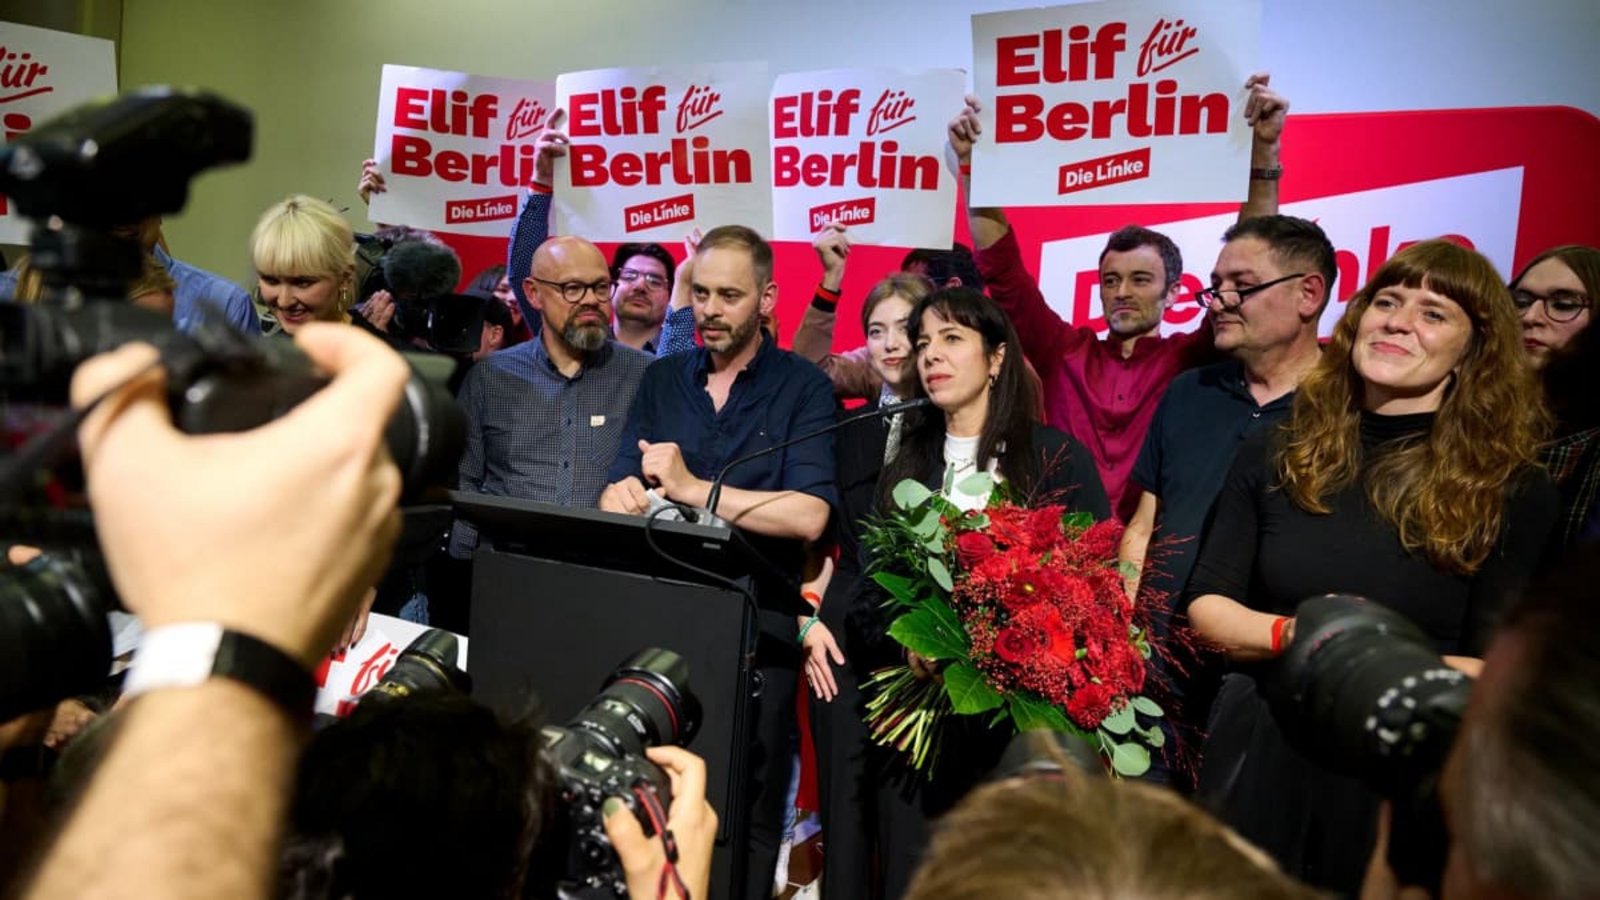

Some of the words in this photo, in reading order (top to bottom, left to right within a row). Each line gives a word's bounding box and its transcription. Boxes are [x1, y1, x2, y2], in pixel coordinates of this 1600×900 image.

[0, 47, 49, 90] ür
[996, 22, 1126, 87] Elif
[1136, 20, 1199, 77] für
[394, 86, 498, 138] Elif
[506, 98, 546, 140] für
[568, 86, 667, 136] Elif
[676, 85, 723, 133] für
[774, 89, 860, 138] Elif
[867, 89, 916, 134] für
[995, 79, 1230, 144] Berlin
[391, 134, 535, 187] Berli
[568, 136, 752, 187] Berlin
[773, 140, 940, 190] Berlin
[1065, 167, 1093, 188] Die
[451, 205, 474, 219] Die
[630, 210, 652, 227] Die
